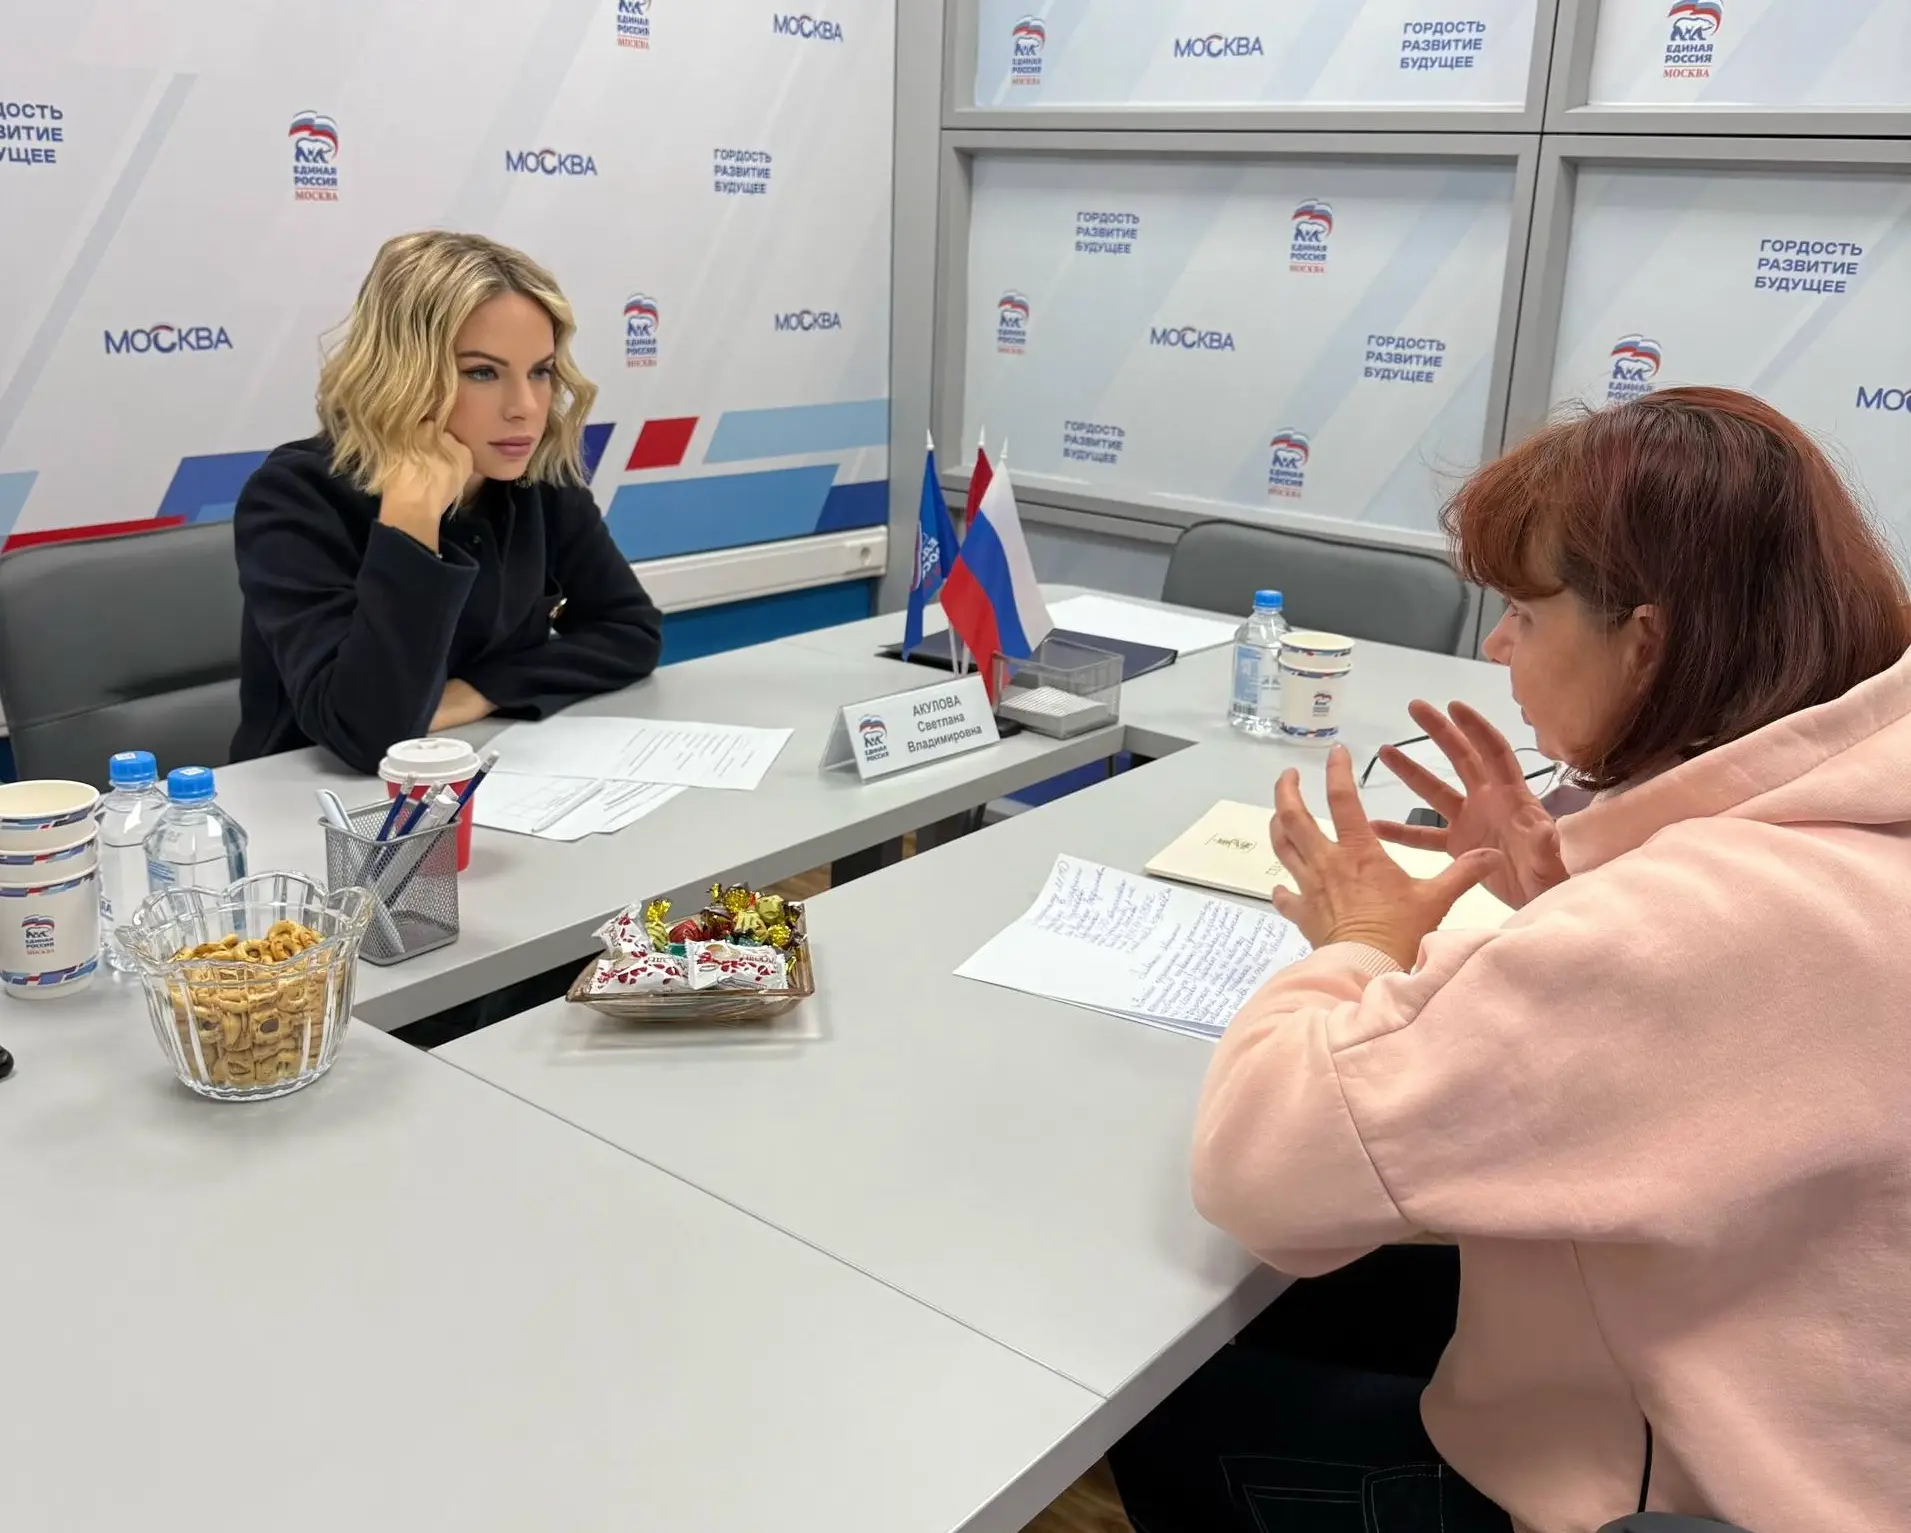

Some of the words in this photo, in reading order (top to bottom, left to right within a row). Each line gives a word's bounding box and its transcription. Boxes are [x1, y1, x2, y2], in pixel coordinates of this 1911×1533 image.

[773, 13, 843, 43] МОСКВА
[1403, 20, 1486, 36] ГОРДОСТЬ
[1174, 33, 1264, 58] МОСКВА
[1401, 38, 1483, 51] РАЗВИТИЕ
[1666, 43, 1714, 53] ЕДИНАЯ
[1400, 55, 1474, 71] БУДУЩЕЕ
[1664, 54, 1712, 63] РОССИЯ
[1663, 68, 1709, 78] МОСКВА
[505, 148, 598, 177] МОСКВА
[714, 148, 772, 163] ГОРДОСТЬ
[293, 165, 337, 175] ЕДИНАЯ
[714, 164, 771, 179] РАЗВИТИЕ
[294, 176, 338, 186] РОССИЯ
[714, 181, 767, 195] БУДУЩЕЕ
[295, 191, 339, 201] МОСКВА
[1077, 211, 1140, 225] ГОРДОСТЬ
[1076, 226, 1137, 240] РАЗВИТИЕ
[1075, 241, 1132, 255] БУДУЩЕЕ
[1760, 239, 1863, 256] ГОРДОСТЬ
[1757, 258, 1859, 275] РАЗВИТИЕ
[1754, 276, 1847, 294] БУДУЩЕЕ
[775, 310, 842, 332] МОСКВА
[104, 322, 233, 355] МОСКВА
[1150, 325, 1236, 353] МОСКВА
[1367, 334, 1446, 351] ГОРДОСТЬ
[1365, 351, 1443, 367] РАЗВИТИЕ
[1363, 367, 1434, 383] БУДУЩЕЕ
[1064, 420, 1125, 438] ГОРДОСТЬ
[1064, 434, 1123, 451] РАЗВИТИЕ
[1063, 448, 1118, 464] БУДУЩЕЕ
[912, 695, 962, 717] АКУЛОВА
[917, 712, 965, 733] Светлана
[907, 725, 982, 753] Владимировна
